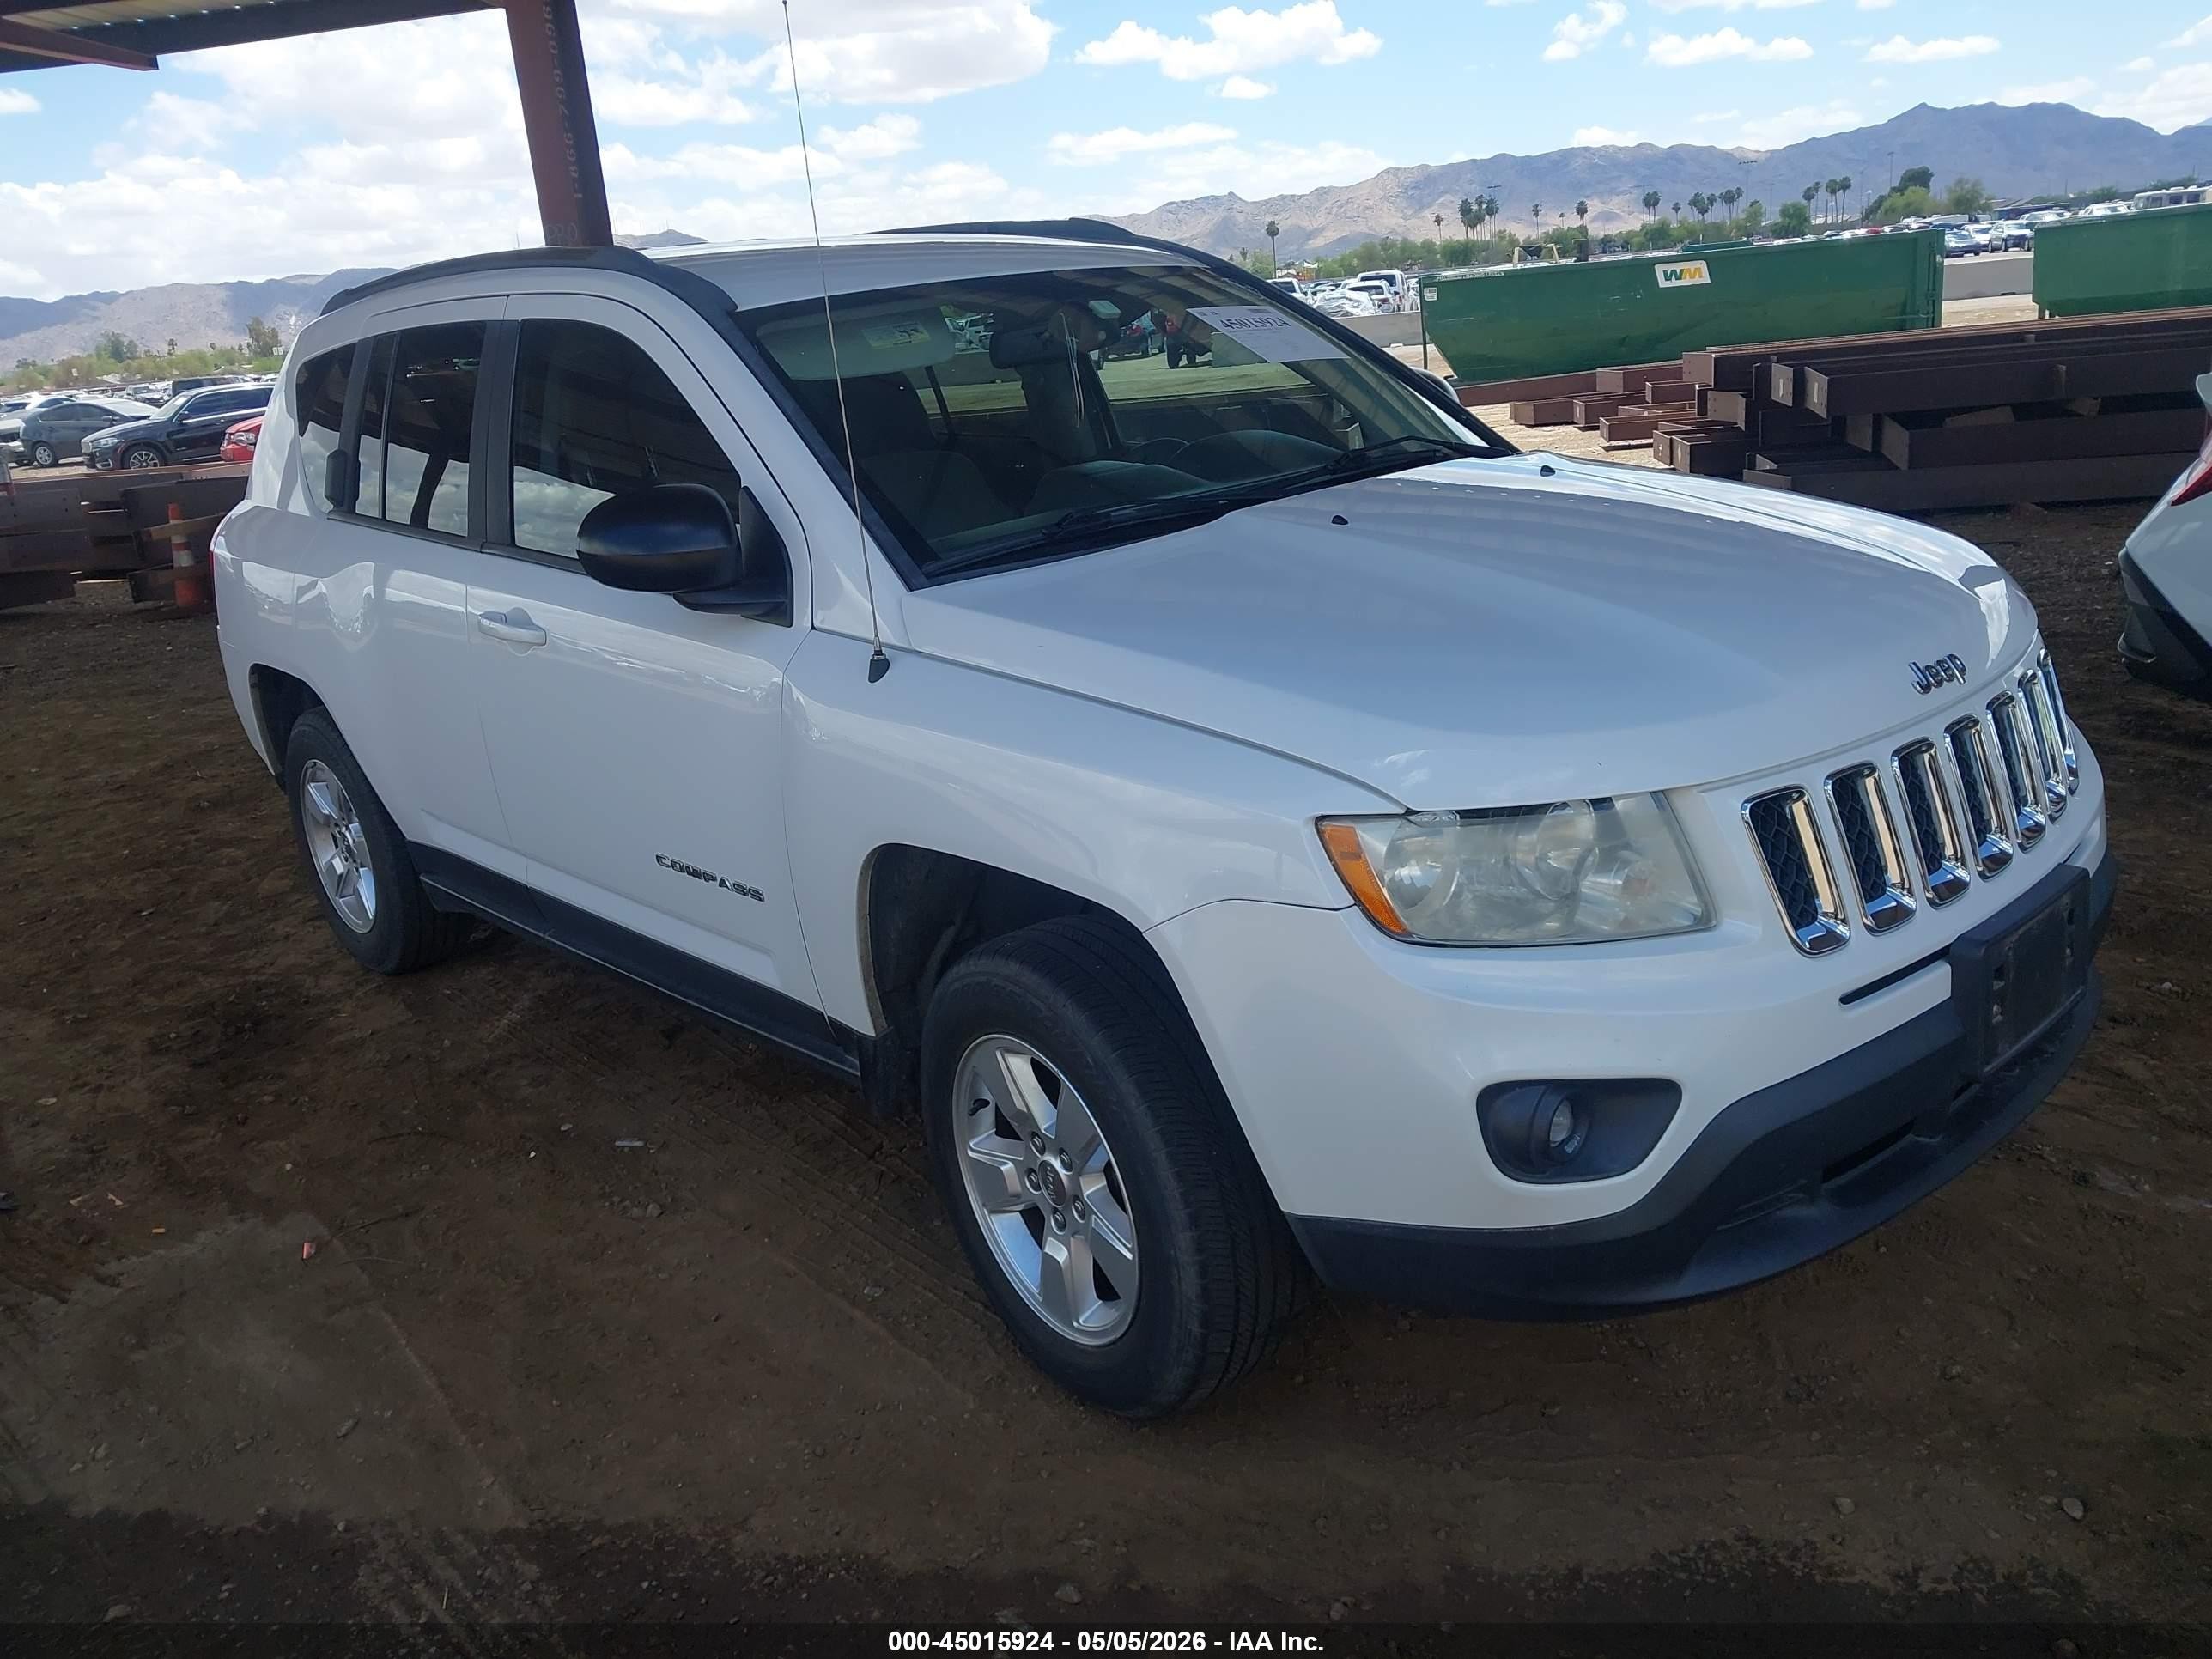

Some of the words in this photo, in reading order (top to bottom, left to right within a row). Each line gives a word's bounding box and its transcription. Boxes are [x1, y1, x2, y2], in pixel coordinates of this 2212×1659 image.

[543, 0, 583, 198] 1-866-799-096
[1662, 266, 1704, 282] WM
[1220, 317, 1291, 330] 45015924
[1908, 653, 1967, 695] Jeep
[655, 853, 765, 902] COMPASS
